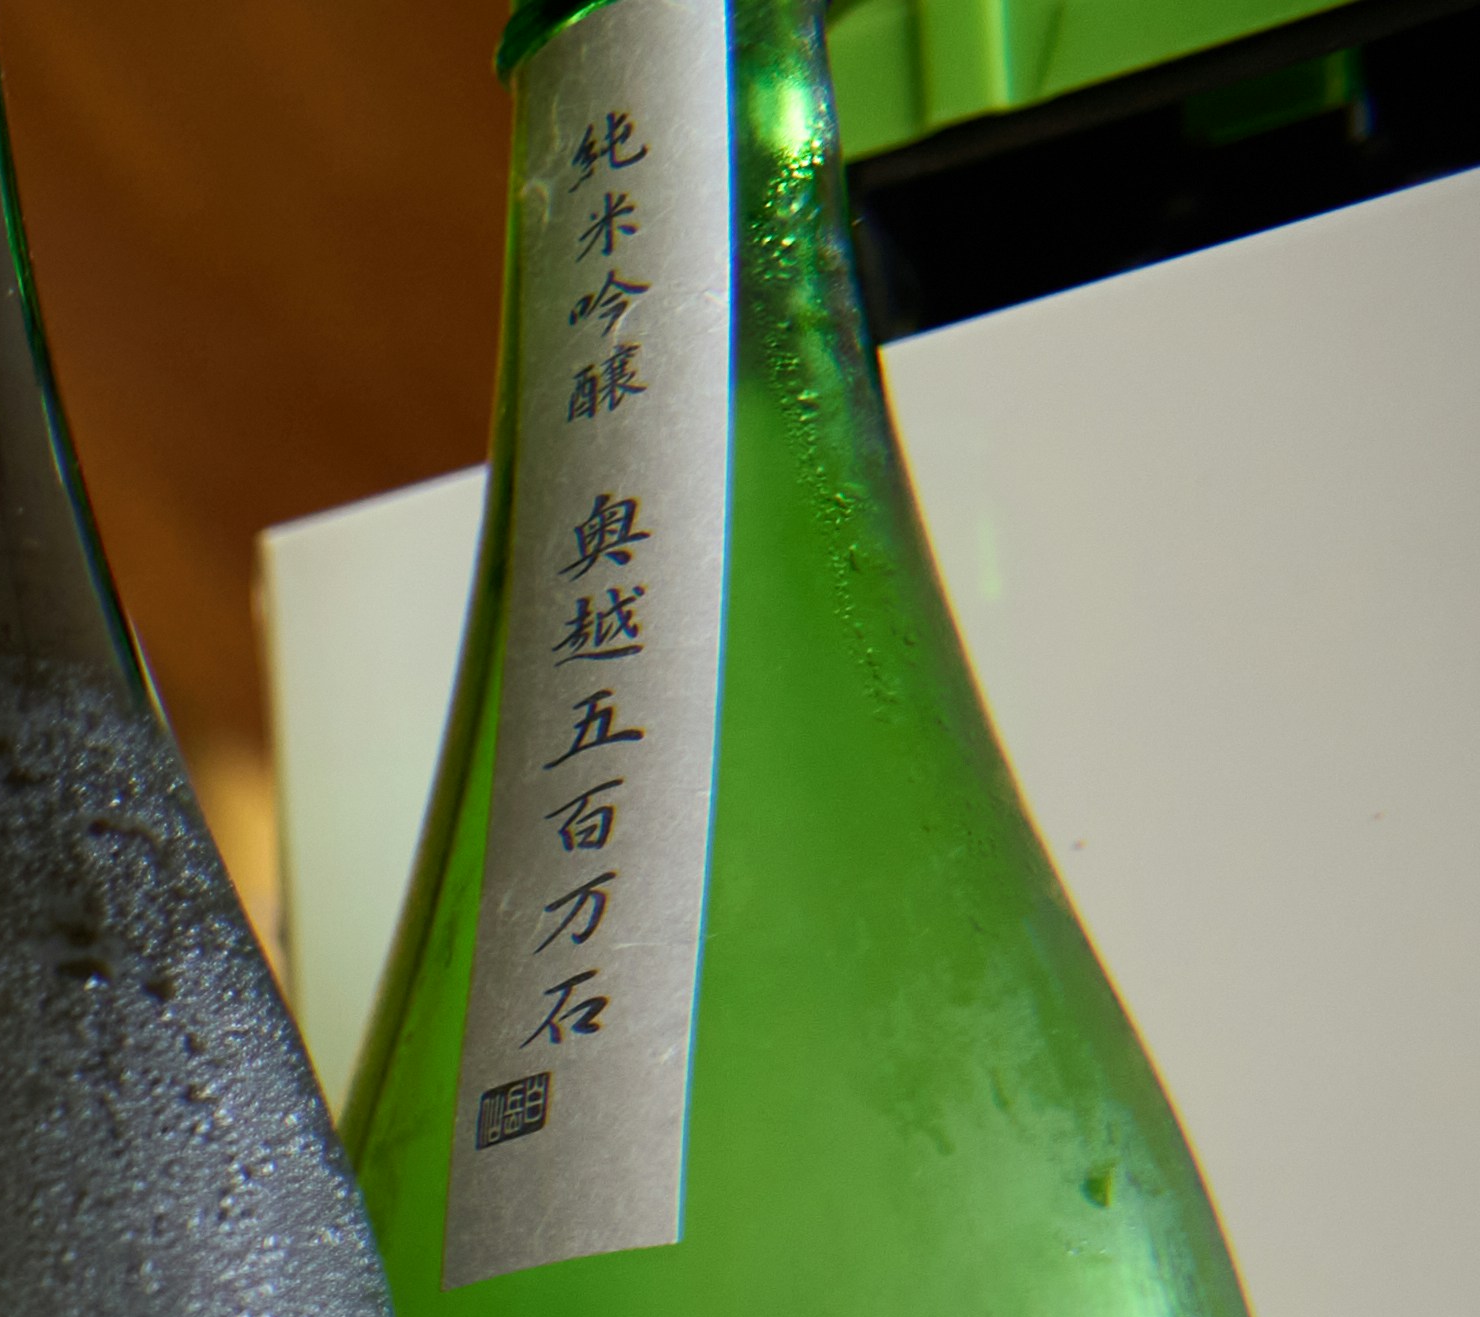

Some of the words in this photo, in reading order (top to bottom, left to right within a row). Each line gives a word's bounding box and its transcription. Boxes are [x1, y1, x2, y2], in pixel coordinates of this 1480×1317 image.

[566, 108, 652, 425] 純米吟醸
[519, 492, 651, 1051] 奥越五百万石
